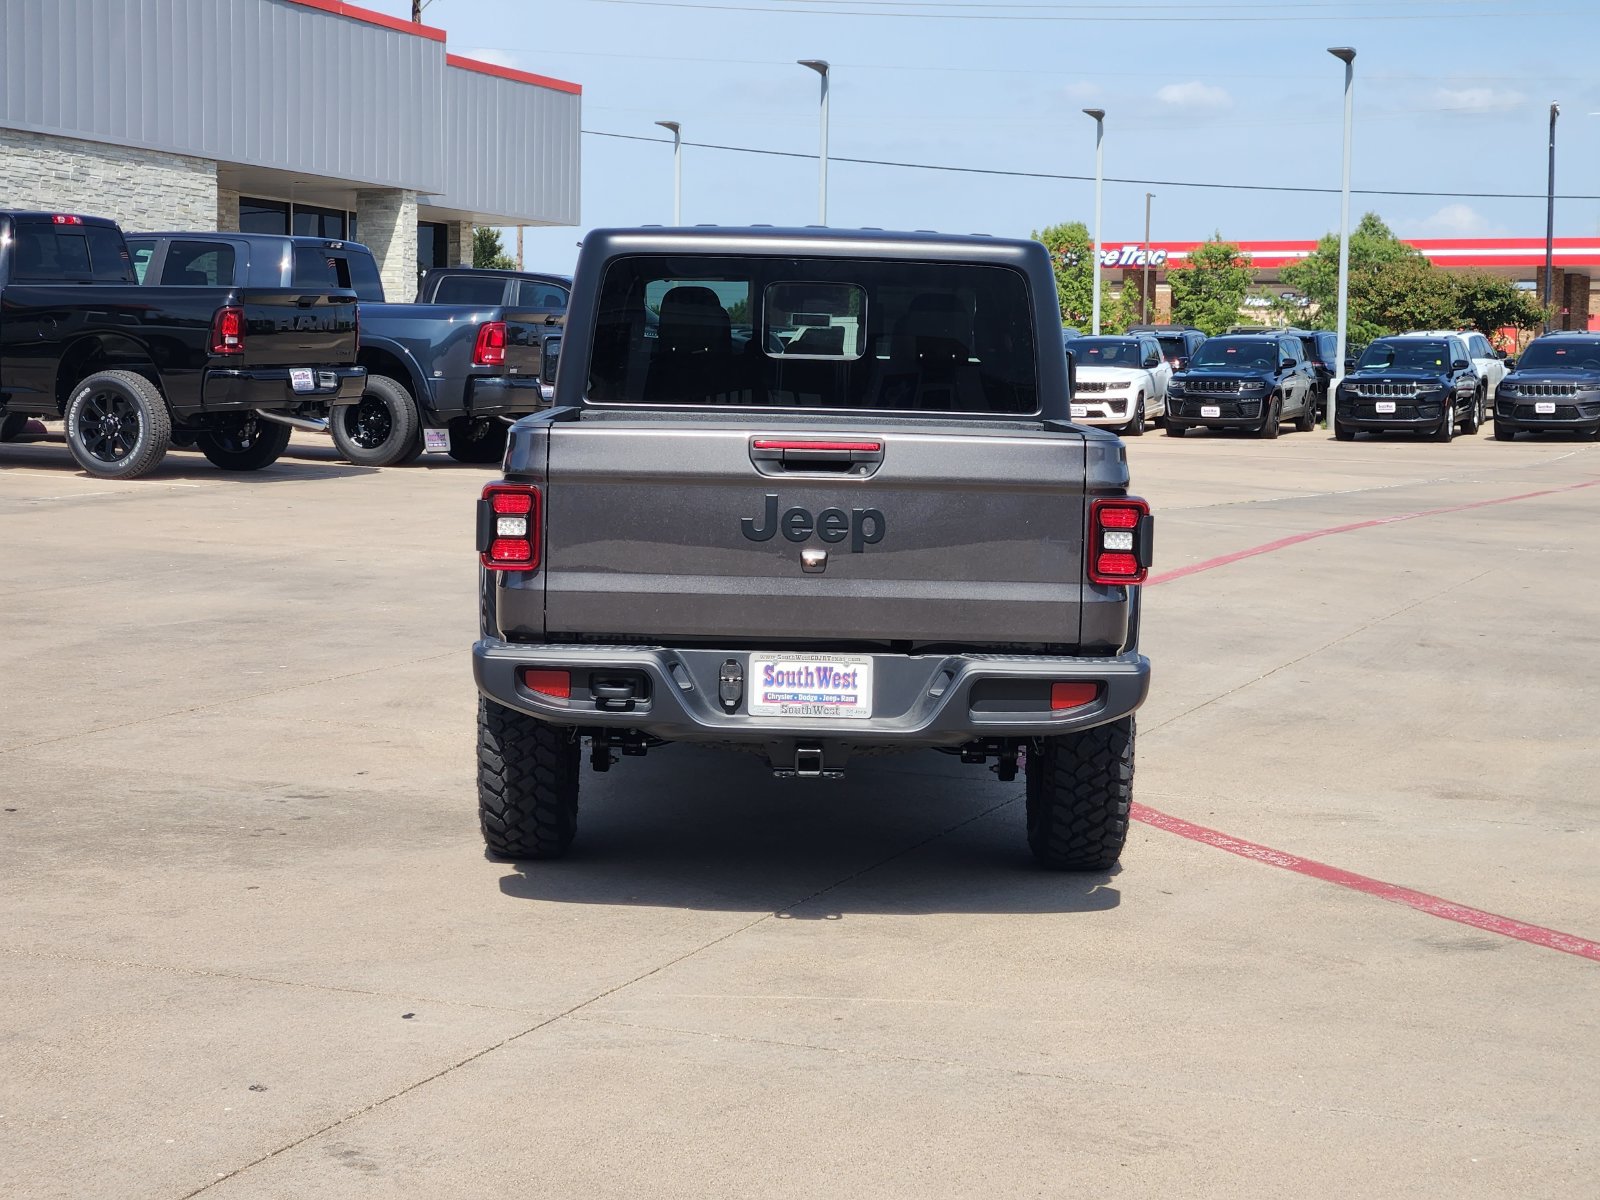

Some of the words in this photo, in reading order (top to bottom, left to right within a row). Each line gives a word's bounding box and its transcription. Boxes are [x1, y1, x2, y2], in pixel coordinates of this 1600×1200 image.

[741, 494, 886, 553] Jeep
[763, 664, 858, 690] SouthWest
[767, 693, 794, 701] Chrysler
[798, 694, 818, 702] Dodge
[822, 695, 838, 703] Jeep
[840, 695, 855, 703] Ram
[780, 704, 841, 716] SouthWest
